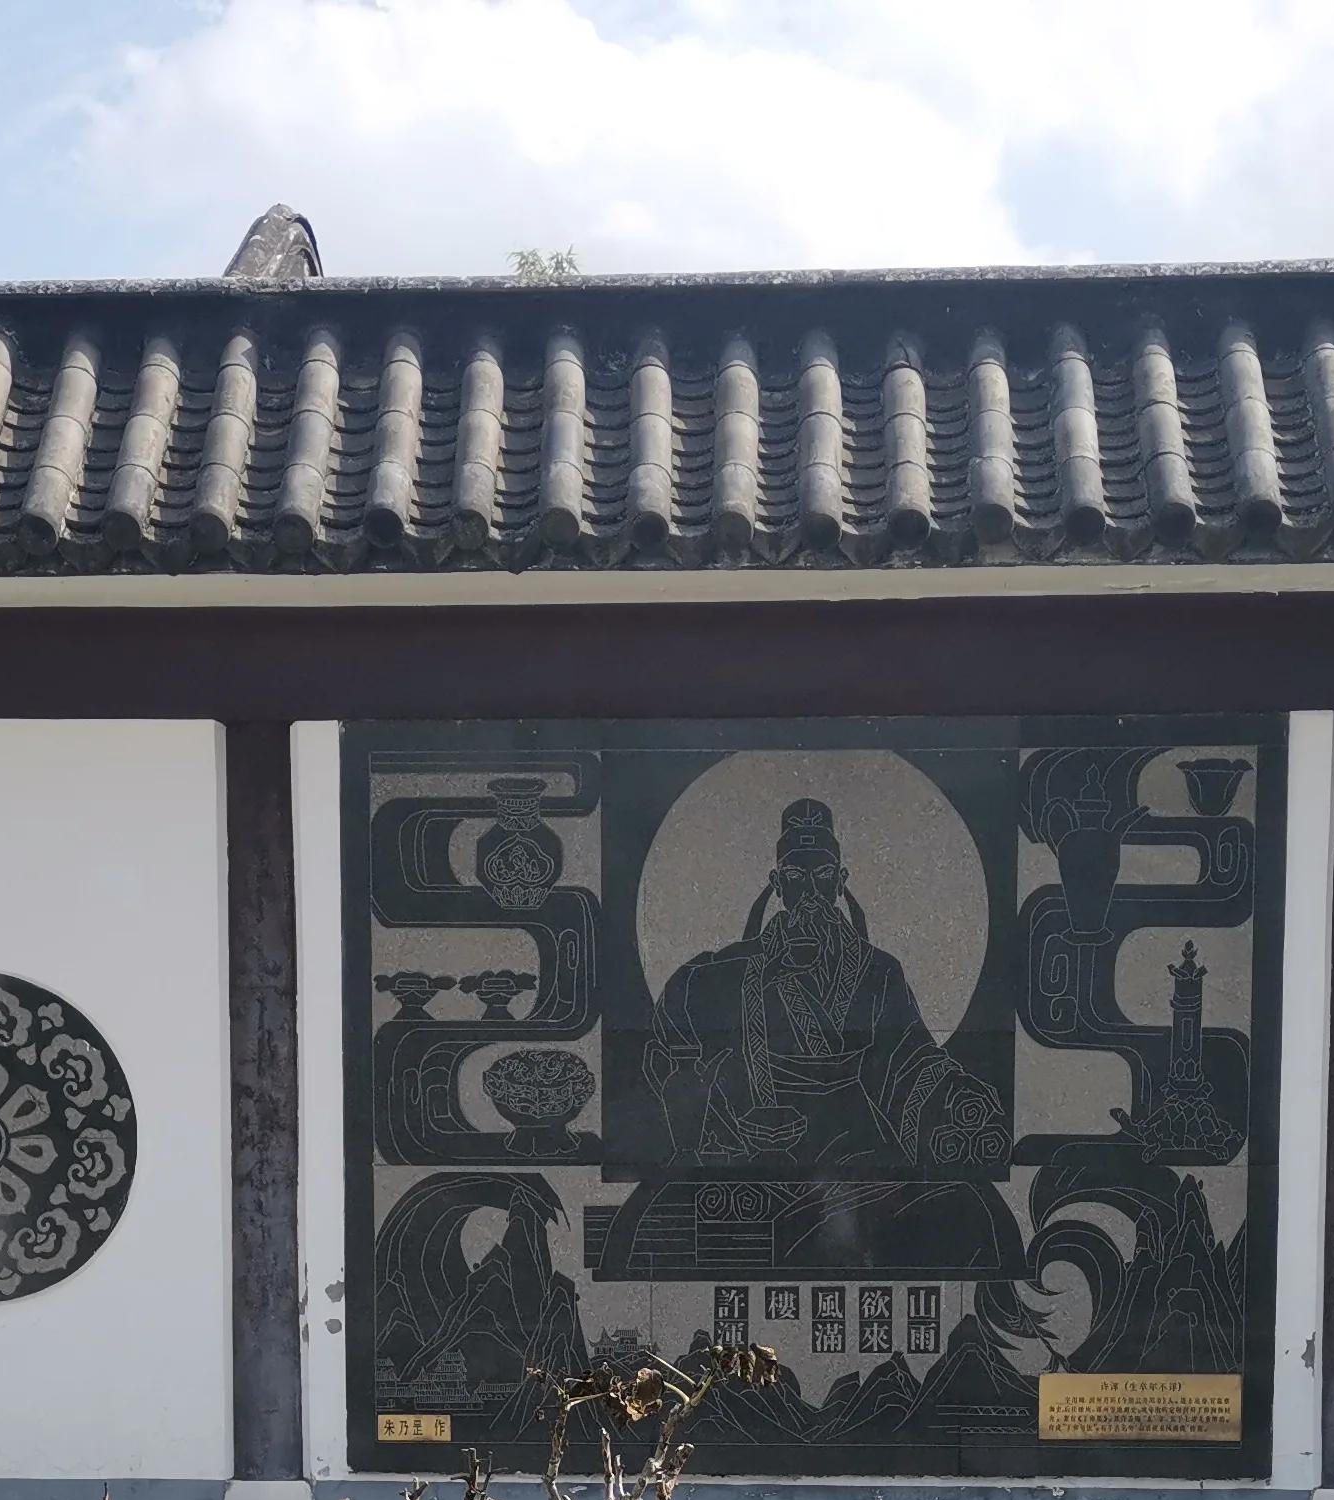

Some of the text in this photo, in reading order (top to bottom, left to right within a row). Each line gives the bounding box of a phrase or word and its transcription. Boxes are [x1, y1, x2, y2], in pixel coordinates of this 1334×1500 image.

[768, 1289, 797, 1320] 樓
[814, 1290, 844, 1352] 風滿
[860, 1289, 891, 1352] 欲來
[908, 1289, 937, 1352] 山雨
[434, 1418, 446, 1437] 作
